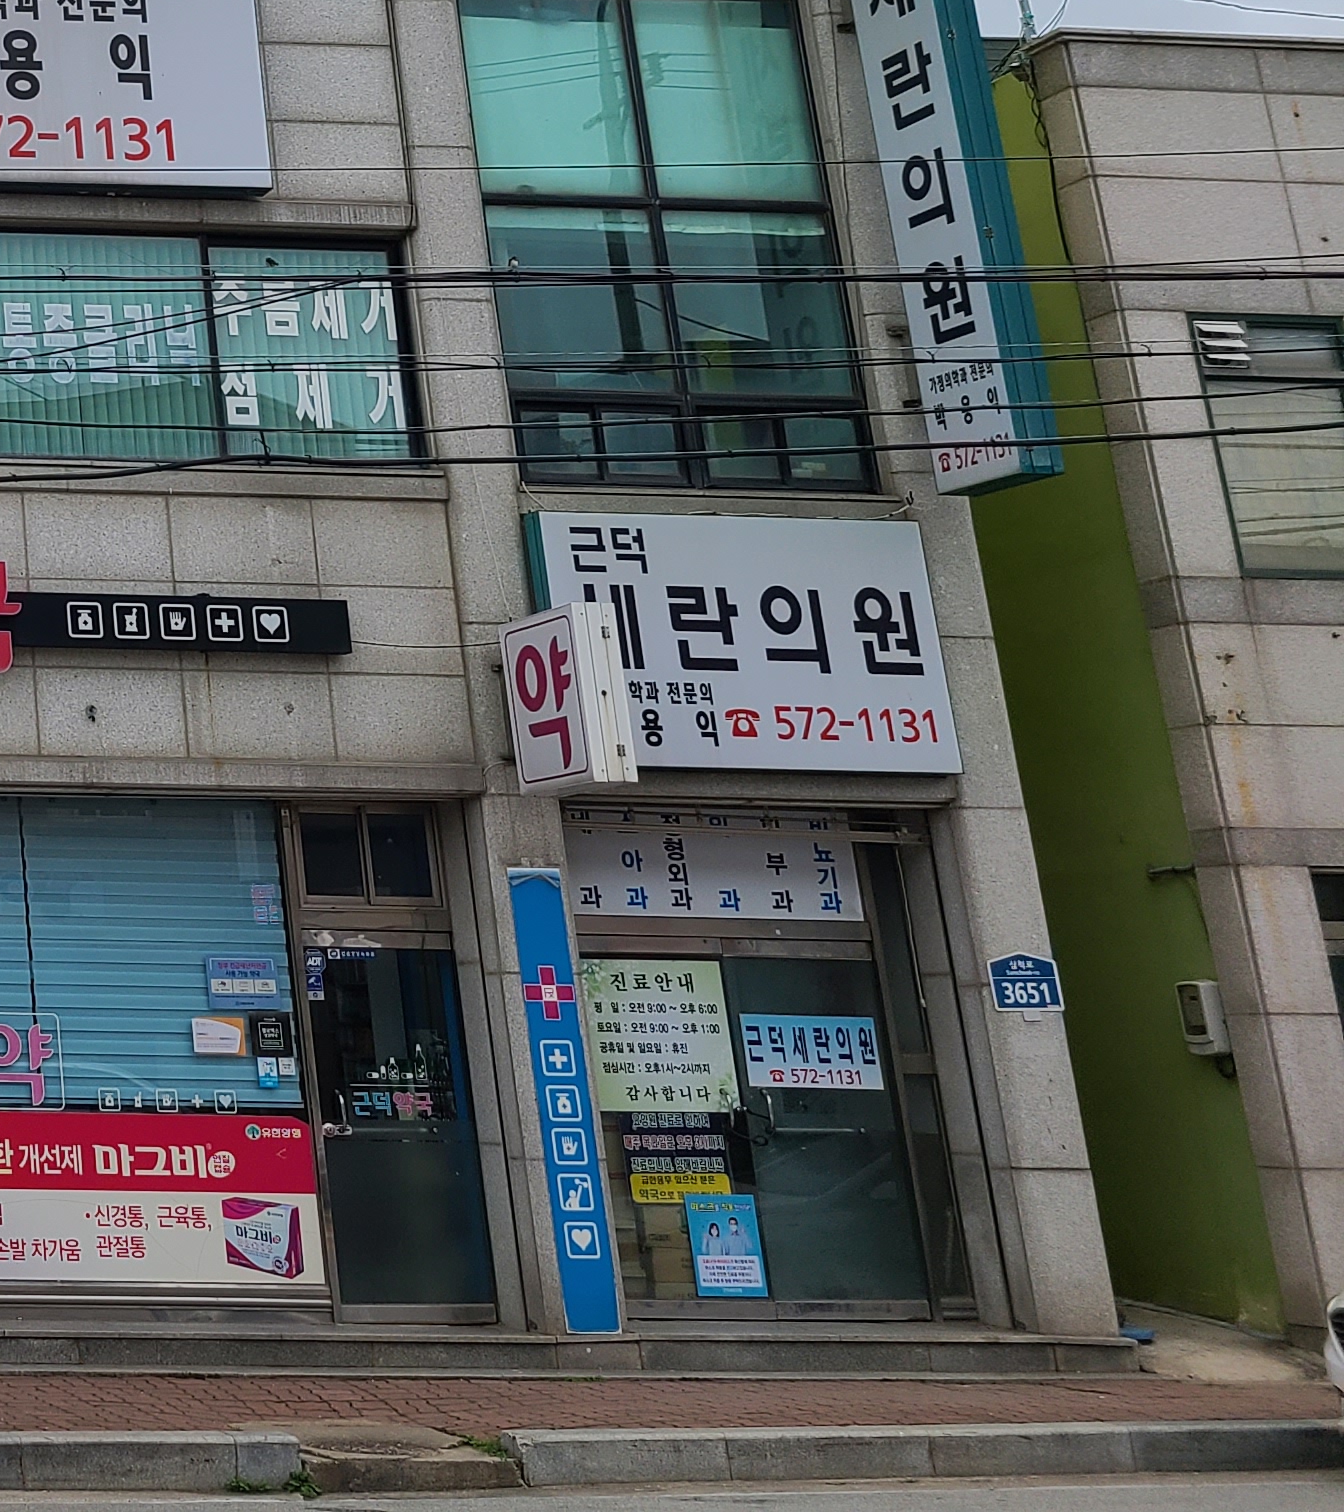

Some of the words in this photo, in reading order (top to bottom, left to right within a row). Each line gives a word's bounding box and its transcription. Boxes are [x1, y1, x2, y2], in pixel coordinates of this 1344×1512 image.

[212, 272, 398, 341] 주름제거
[568, 526, 648, 574] 근덕
[514, 635, 572, 769] 약
[666, 681, 714, 705] 전문의
[774, 706, 939, 743] 572-1131
[306, 957, 321, 967] ADT
[610, 972, 694, 993] 진료안내
[1001, 982, 1051, 1004] 3651
[629, 1002, 645, 1014] 오전
[647, 1003, 667, 1014] 9:00
[680, 1003, 696, 1014] 오후
[698, 1003, 718, 1014] 6:00
[597, 1022, 621, 1033] 토요일
[631, 1022, 647, 1034] 오전
[649, 1023, 669, 1034] 9:00
[682, 1023, 698, 1034] 오후
[701, 1024, 720, 1034] 1:00
[599, 1042, 624, 1053] 공휴일
[626, 1042, 635, 1053] 및
[637, 1042, 662, 1053] 일요일
[672, 1043, 688, 1054] 휴진
[745, 1025, 877, 1065] 근덕세란의원
[603, 1062, 635, 1074] 점심시간
[791, 1069, 862, 1085] 572-1131
[352, 1091, 433, 1117] 근덕약국
[626, 1085, 712, 1102] 감사합니다
[19, 1143, 84, 1175] 개선제
[92, 1143, 208, 1178] 마그비
[94, 1204, 149, 1231] 신경통,
[157, 1205, 213, 1232] 근육통,
[235, 1225, 273, 1243] 마그비
[31, 1238, 82, 1262] 차가움
[96, 1235, 147, 1259] 관절통
